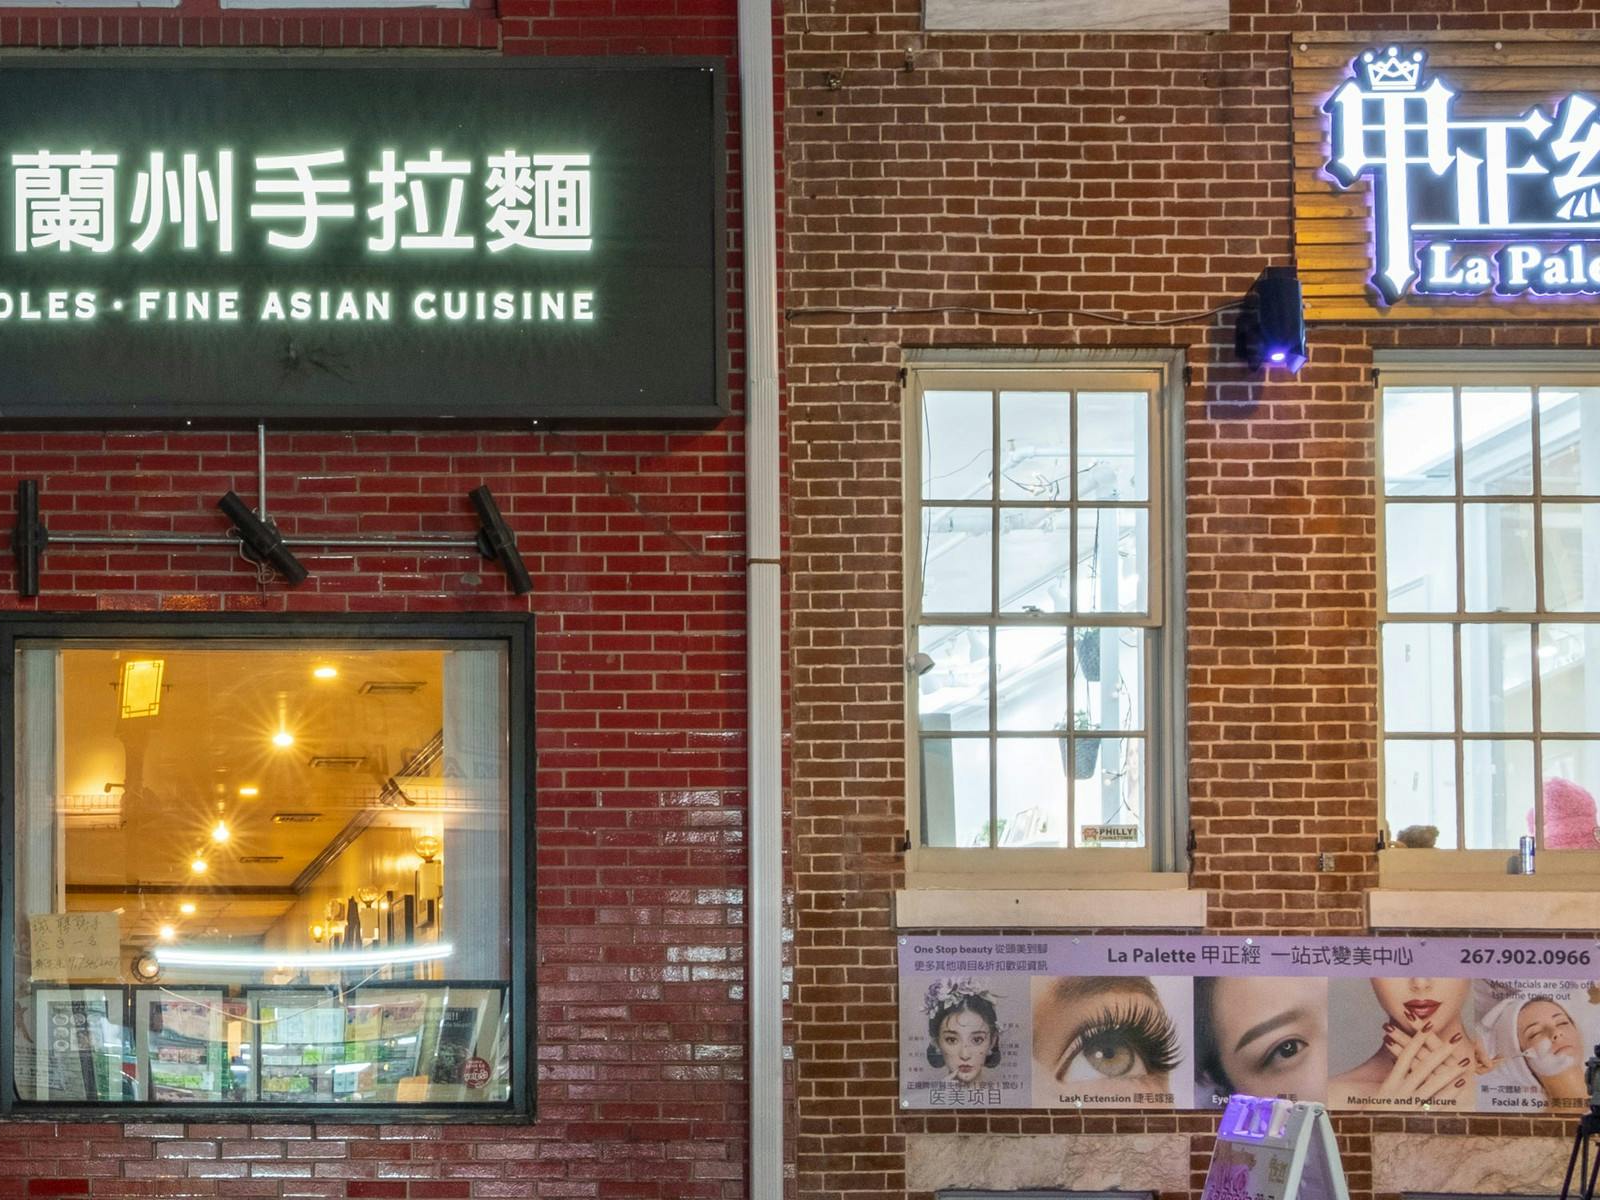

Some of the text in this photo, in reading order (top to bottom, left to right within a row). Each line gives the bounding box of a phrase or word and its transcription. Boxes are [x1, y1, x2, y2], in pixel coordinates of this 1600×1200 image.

[11, 150, 593, 252] 蘭州手拉麵
[1429, 245, 1490, 285] La
[138, 291, 239, 321] FINE
[260, 291, 390, 321] ASIAN
[413, 291, 594, 321] CUISINE
[1100, 828, 1133, 836] PHILLY
[914, 944, 993, 955] One Stop beauty
[1108, 946, 1196, 964] La Palette
[1460, 948, 1591, 966] 267.902.0966
[1514, 980, 1541, 989] facials
[1543, 981, 1557, 989] are
[1556, 992, 1571, 1000] out
[1060, 1094, 1131, 1103] Lash Extension
[1347, 1096, 1457, 1106] Manicure and Pedicure
[1492, 1098, 1549, 1108] Facial & Spa
